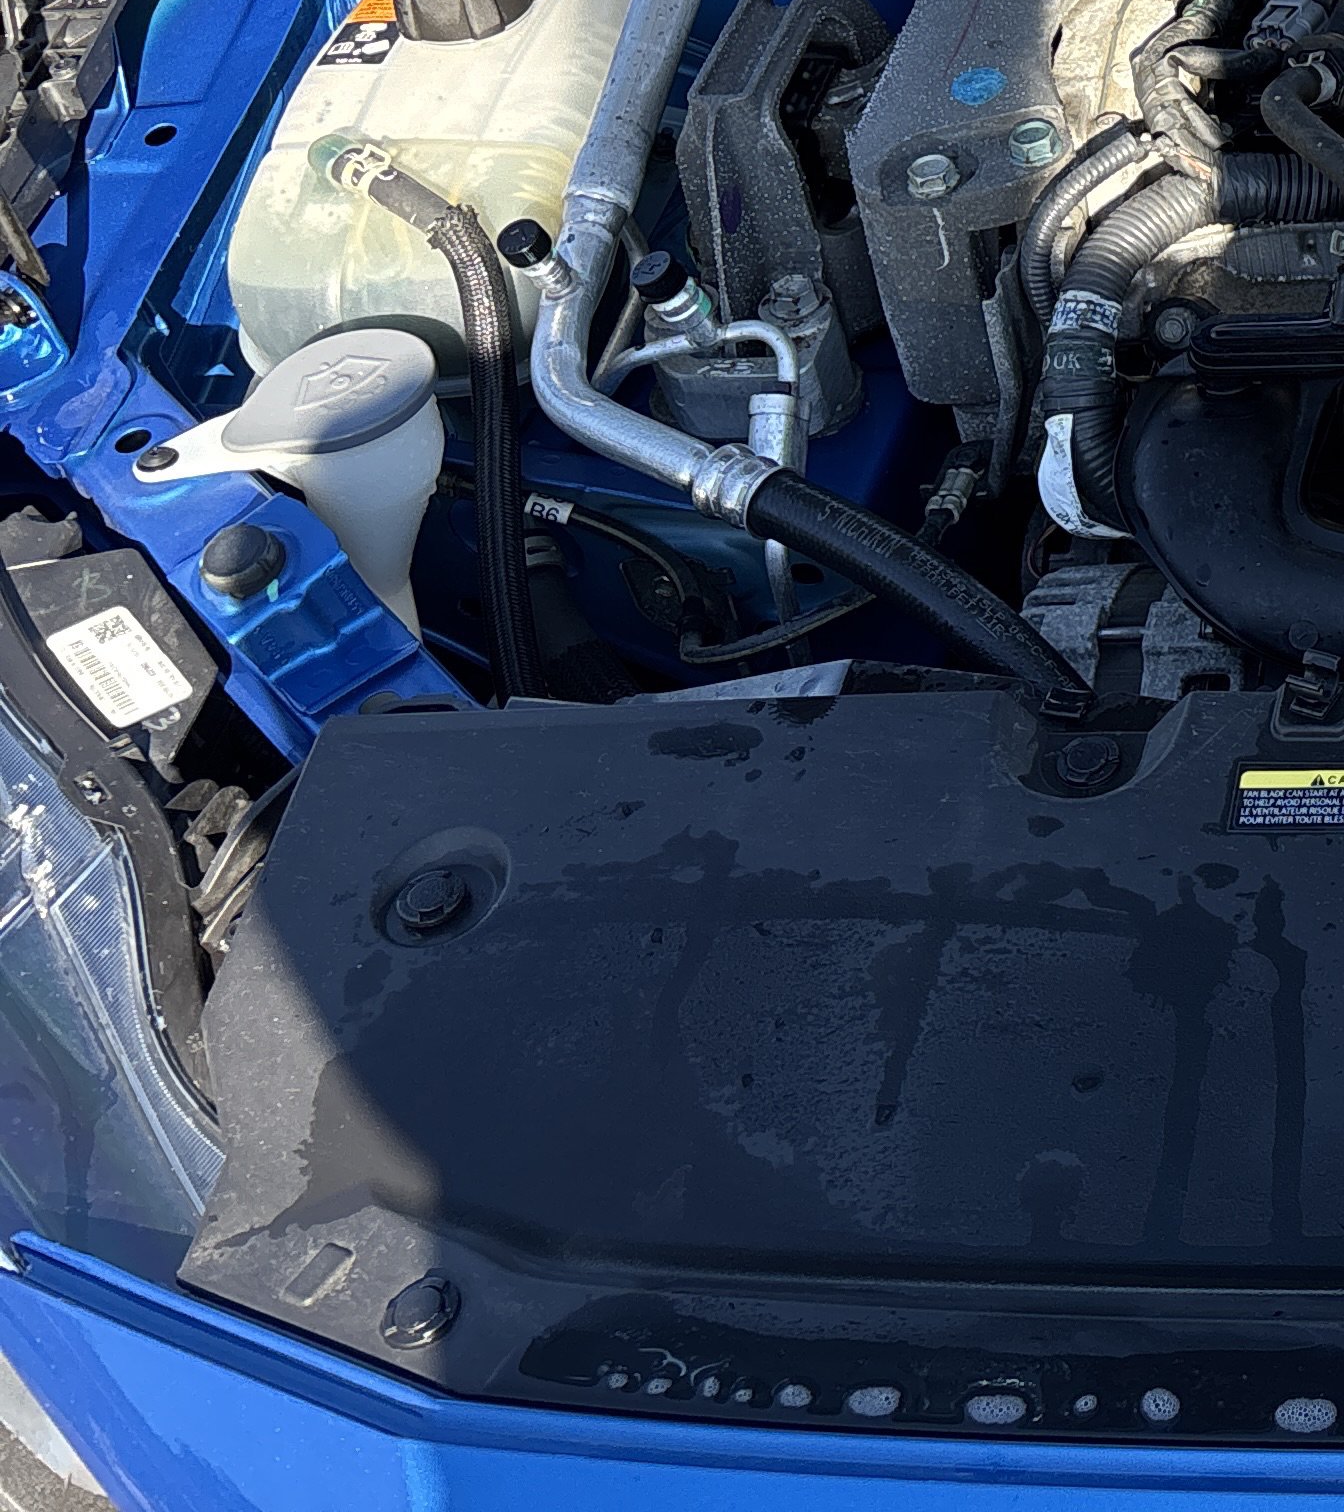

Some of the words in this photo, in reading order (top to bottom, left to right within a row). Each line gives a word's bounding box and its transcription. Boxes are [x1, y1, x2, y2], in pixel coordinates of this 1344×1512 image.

[530, 501, 560, 522] B6
[1243, 790, 1259, 798] FAN
[1260, 789, 1285, 798] BLADE
[1286, 789, 1303, 798] CAN
[1304, 788, 1328, 797] START
[1328, 788, 1338, 797] AT
[1243, 799, 1254, 807] TO
[1254, 798, 1275, 807] HELP
[1275, 798, 1301, 806] AVOID
[1301, 797, 1341, 806] PERSONAL
[1240, 807, 1250, 816] LE
[1251, 806, 1308, 815] VENTILATEUR
[1309, 806, 1340, 815] RISQUE
[1239, 816, 1264, 825] POUR
[1295, 815, 1323, 824] TOUTE
